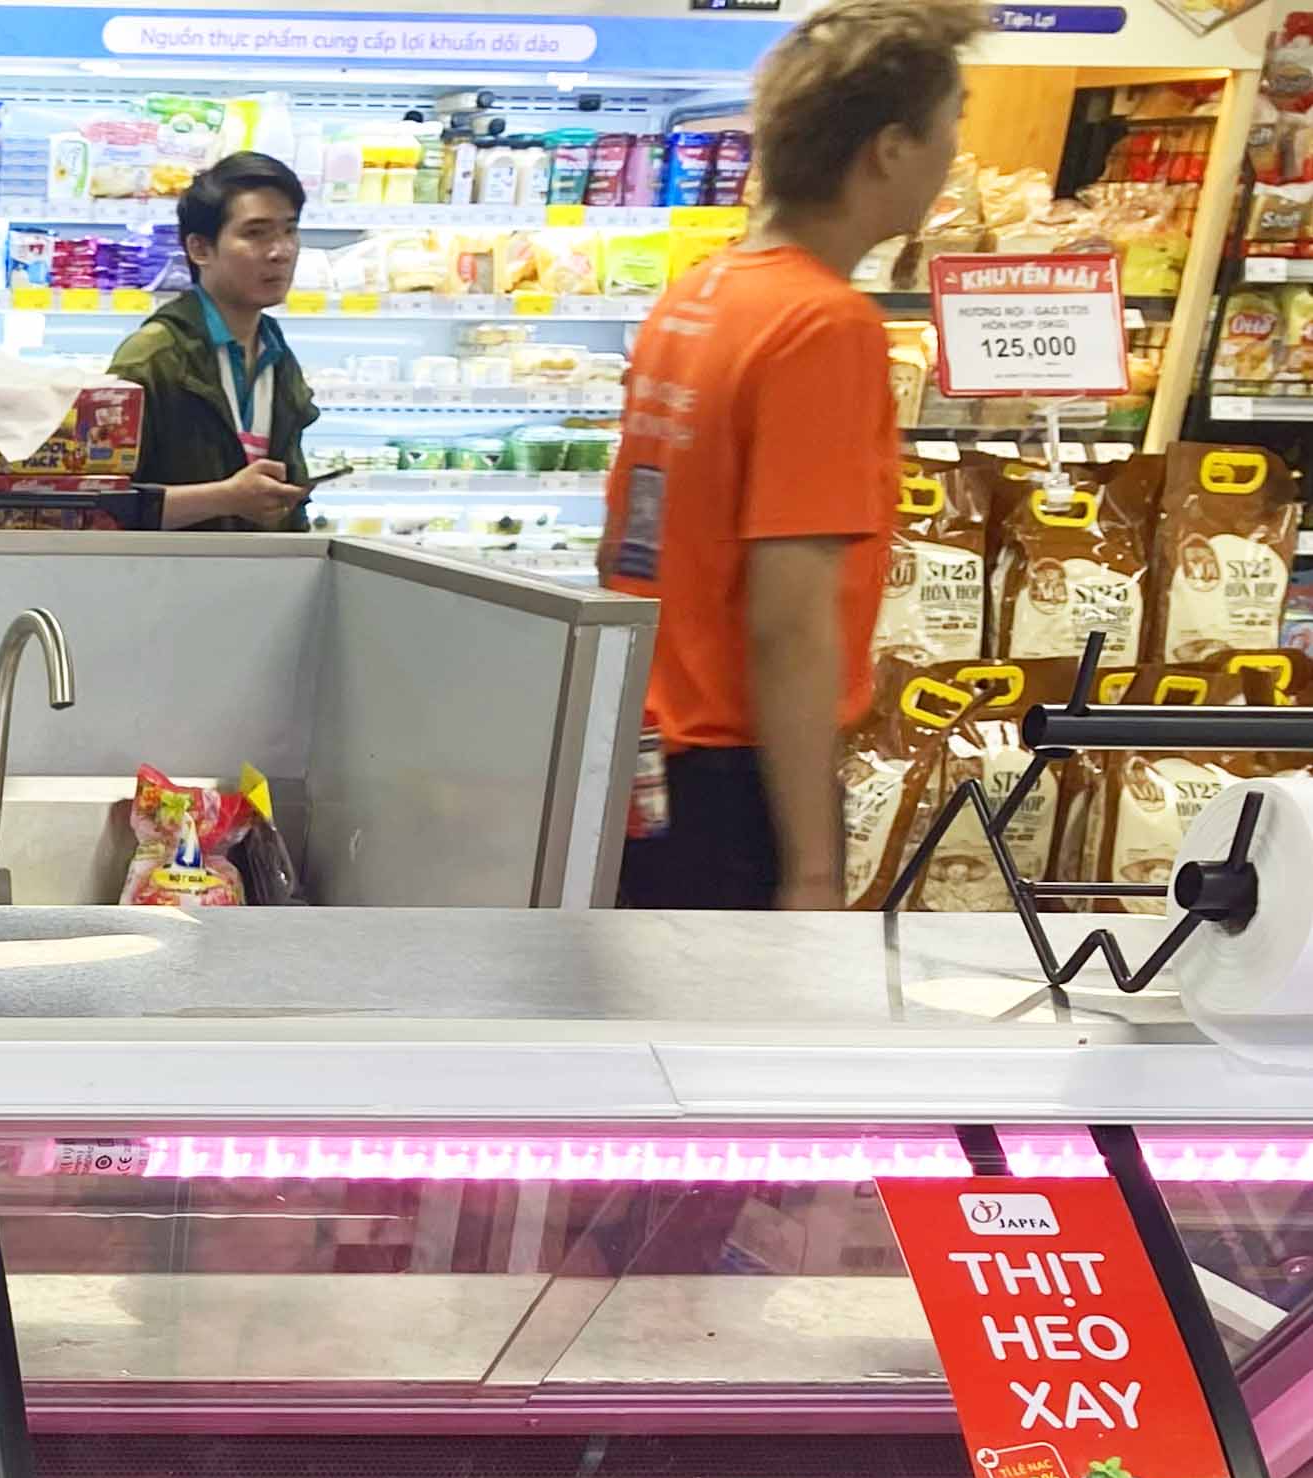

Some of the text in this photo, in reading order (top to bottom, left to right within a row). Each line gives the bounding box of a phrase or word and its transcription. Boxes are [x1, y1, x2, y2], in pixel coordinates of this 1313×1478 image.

[312, 34, 357, 55] cung
[960, 262, 1052, 291] KHUYẾN
[999, 1217, 1051, 1230] JAPFA
[948, 1252, 1105, 1308] THỊT
[981, 1315, 1131, 1361] HEO
[1009, 1381, 1142, 1430] XAY
